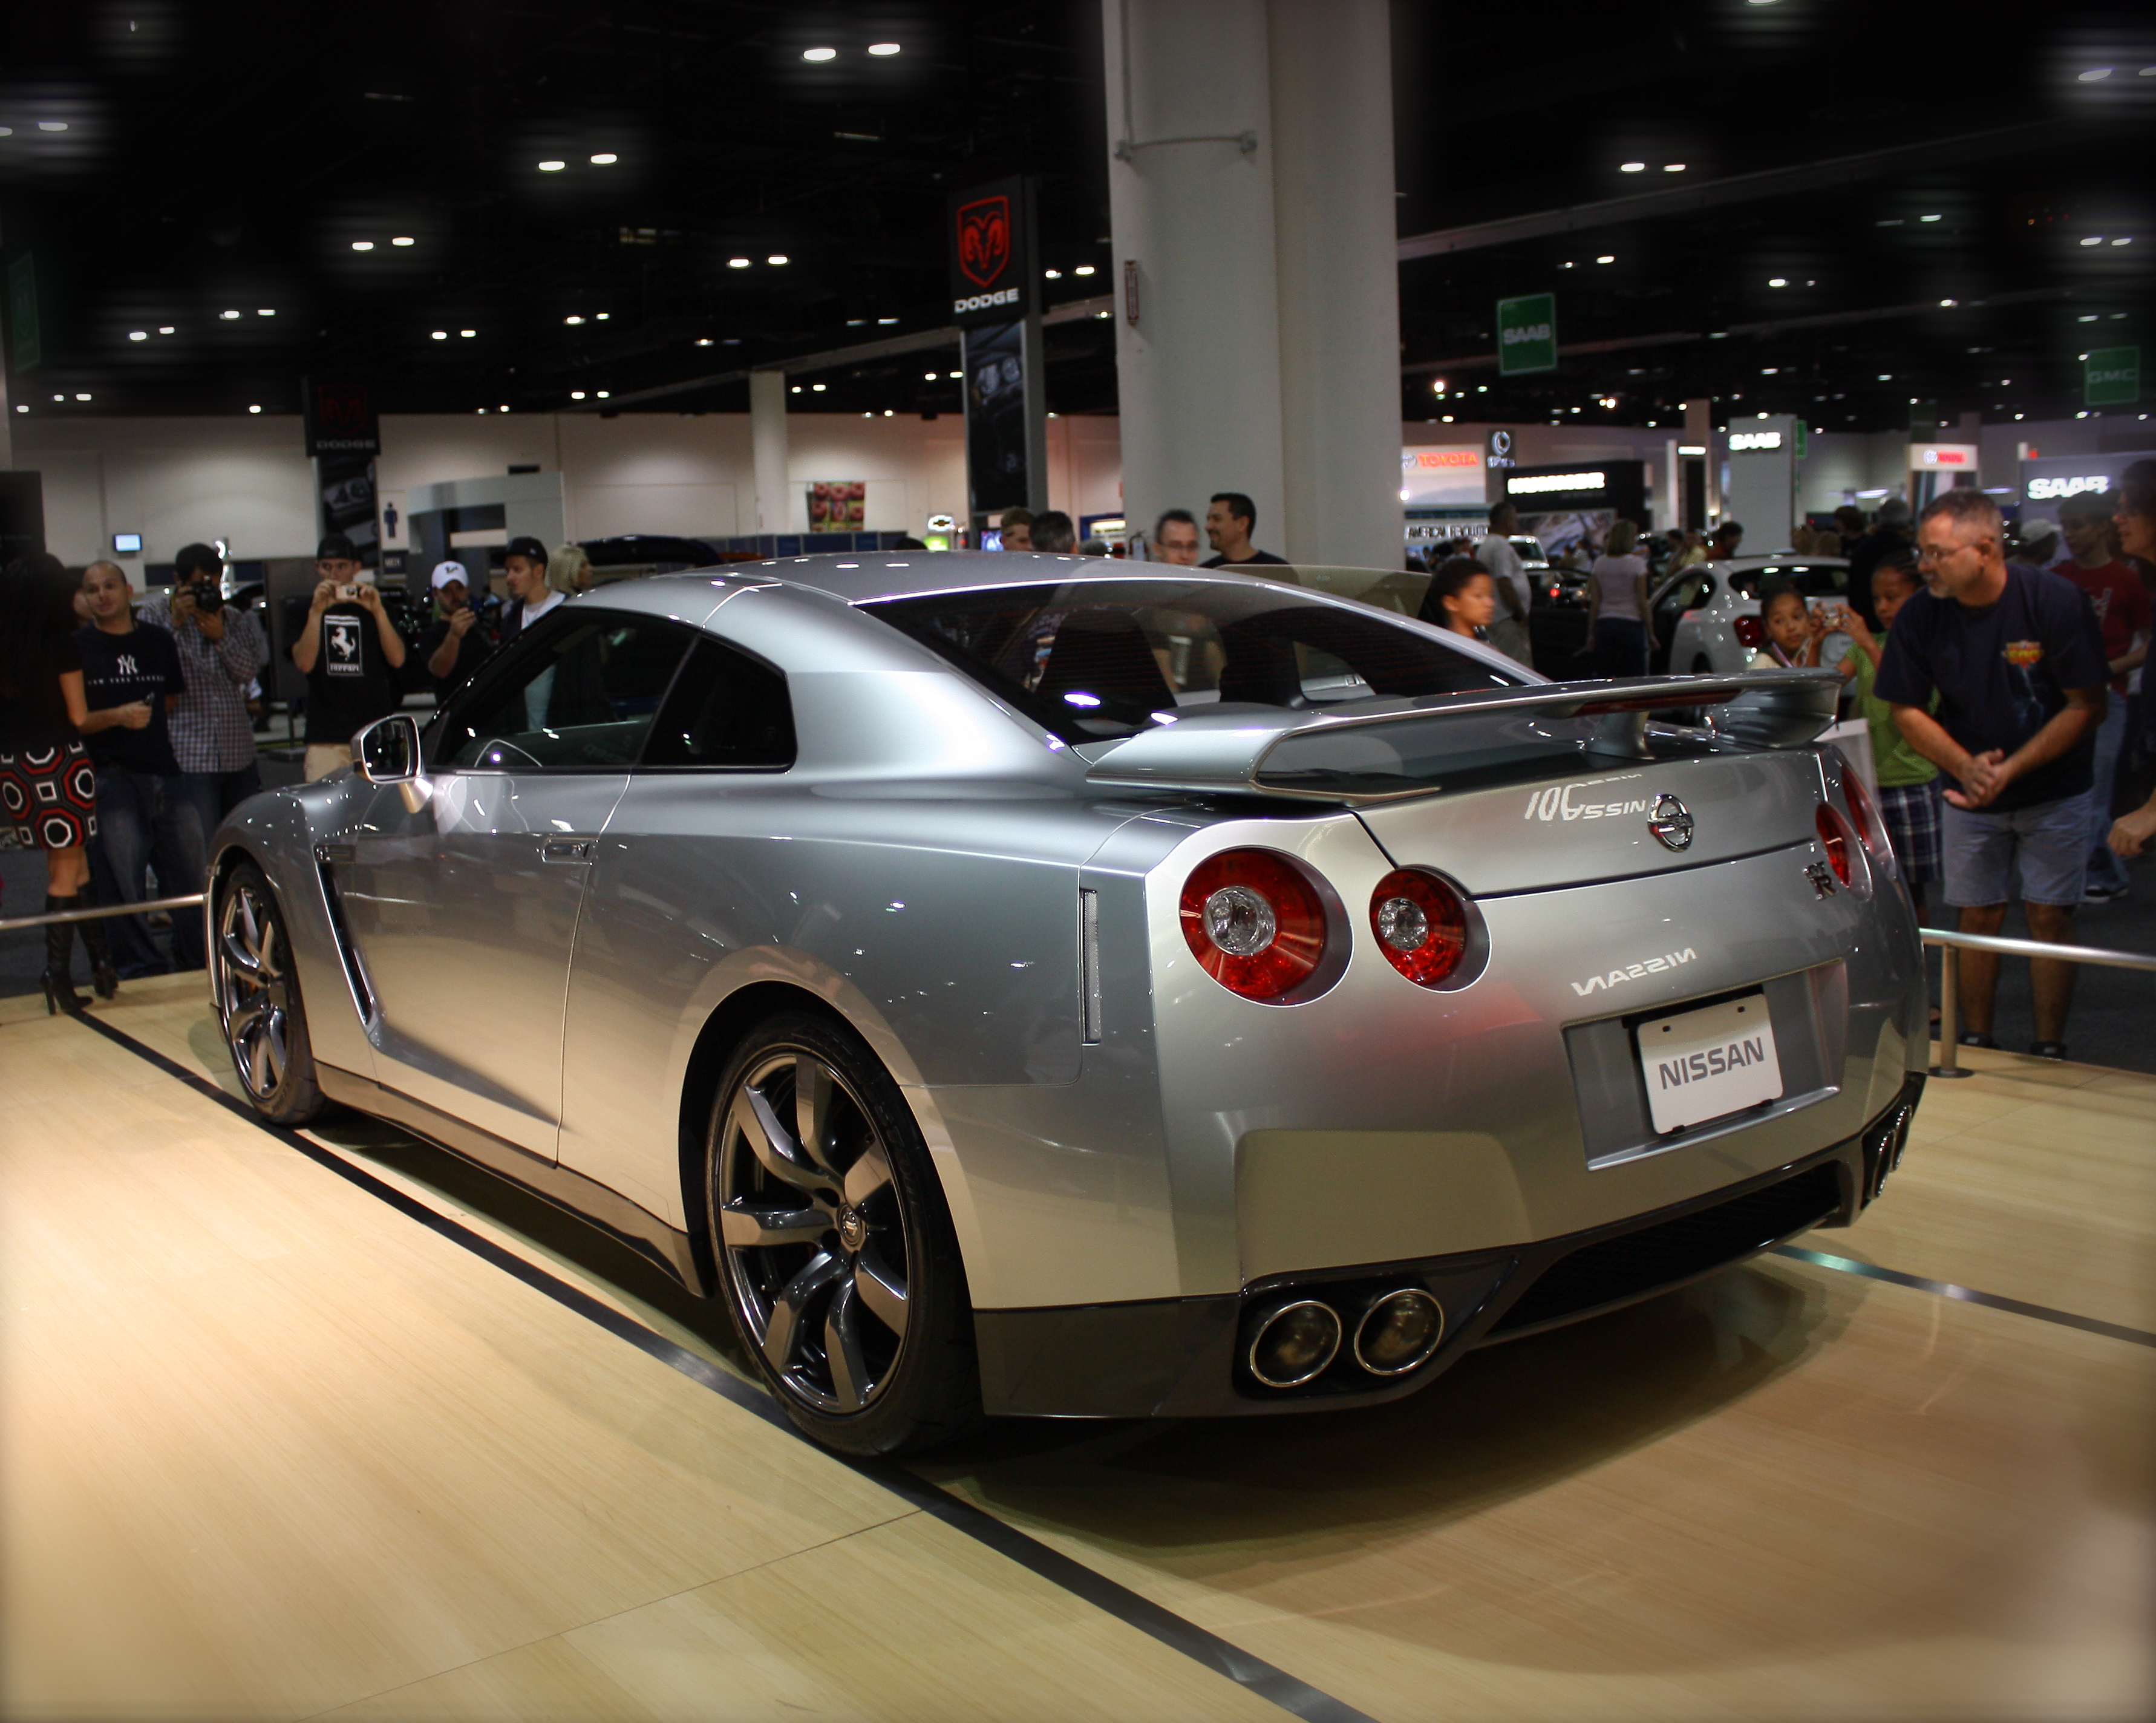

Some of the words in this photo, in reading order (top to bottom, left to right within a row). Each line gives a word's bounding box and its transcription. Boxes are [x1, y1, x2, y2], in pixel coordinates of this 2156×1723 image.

[954, 287, 1019, 313] DODGE
[1503, 324, 1550, 344] SAAB
[2088, 368, 2138, 384] GMC
[316, 440, 375, 450] DODGE
[1420, 453, 1478, 467] TOYOTA
[1659, 1037, 1765, 1090] NISSAN
